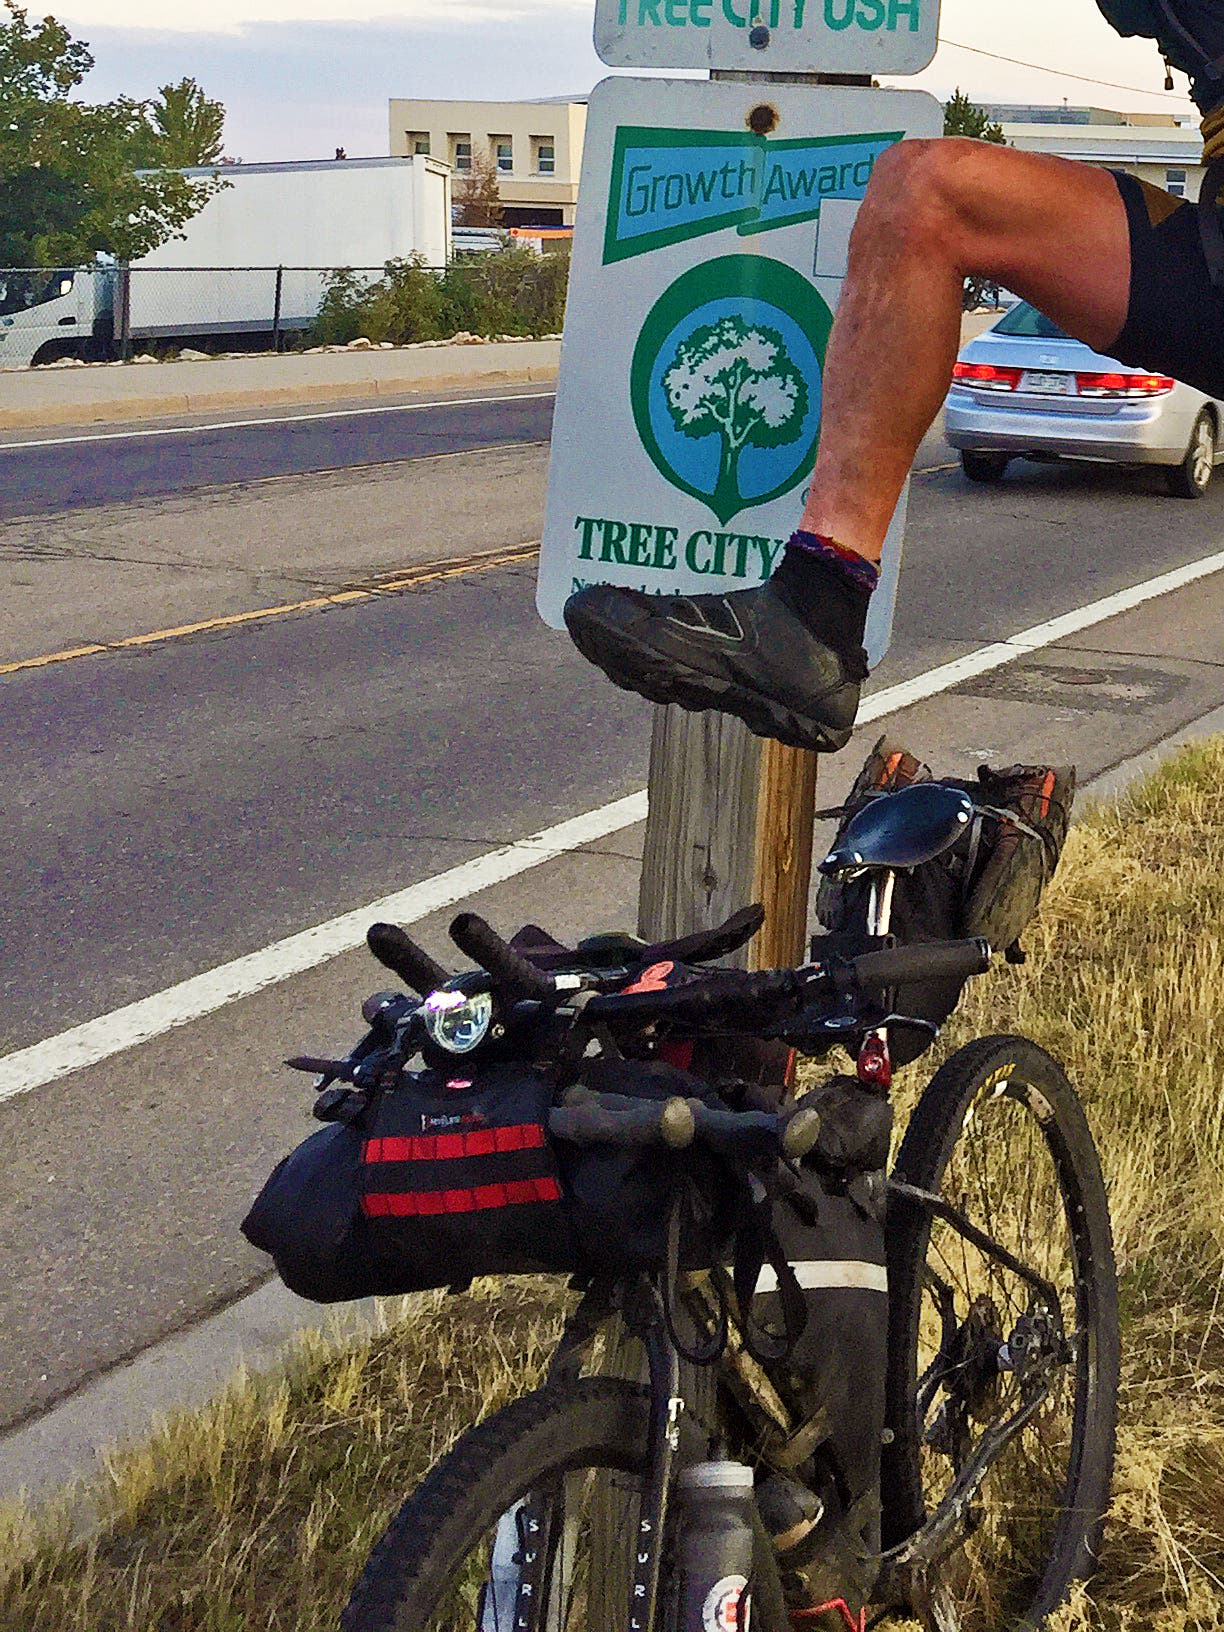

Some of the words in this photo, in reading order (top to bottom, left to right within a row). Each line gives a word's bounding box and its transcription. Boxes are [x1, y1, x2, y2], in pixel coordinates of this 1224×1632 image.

[625, 160, 756, 217] Growth
[761, 153, 875, 205] Award
[574, 515, 679, 570] TREE
[684, 529, 784, 581] CITY
